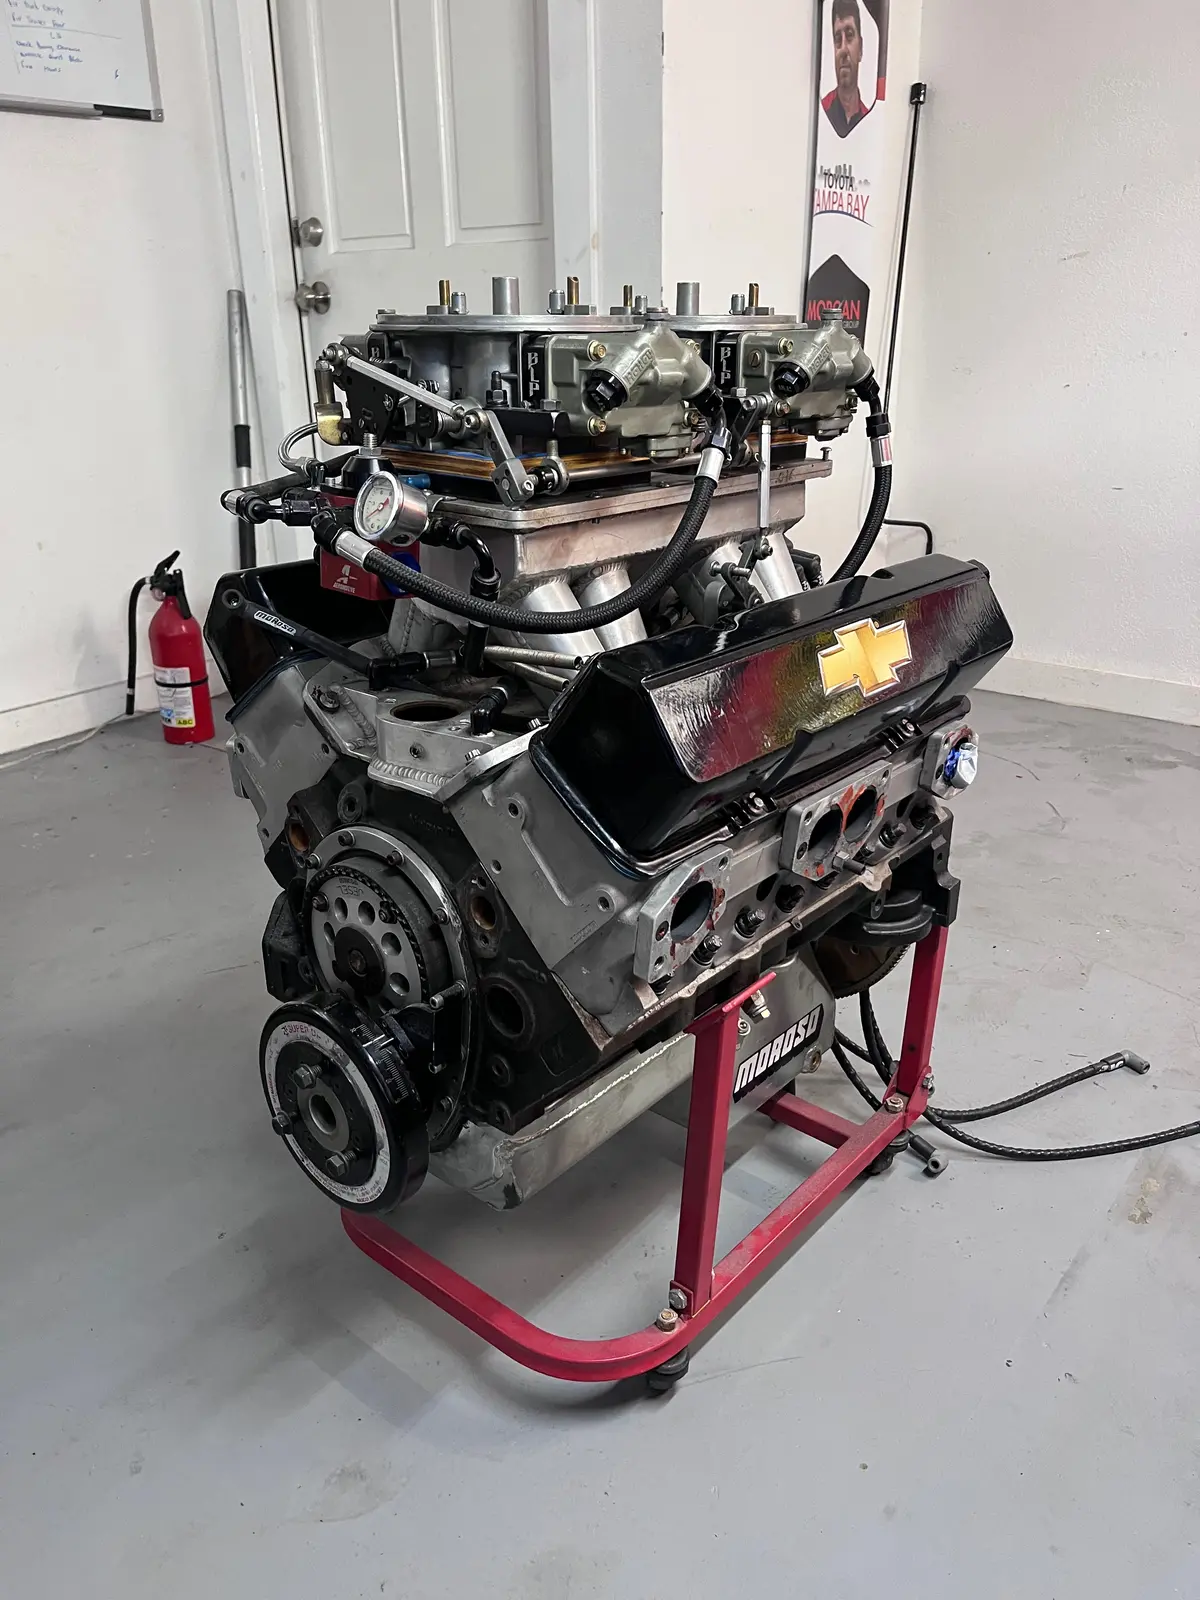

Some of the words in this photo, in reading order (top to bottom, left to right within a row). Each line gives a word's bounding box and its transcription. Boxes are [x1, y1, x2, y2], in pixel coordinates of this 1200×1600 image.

[823, 172, 854, 191] TOYOTA
[847, 193, 870, 221] BAY
[733, 1004, 822, 1095] MOROSO
